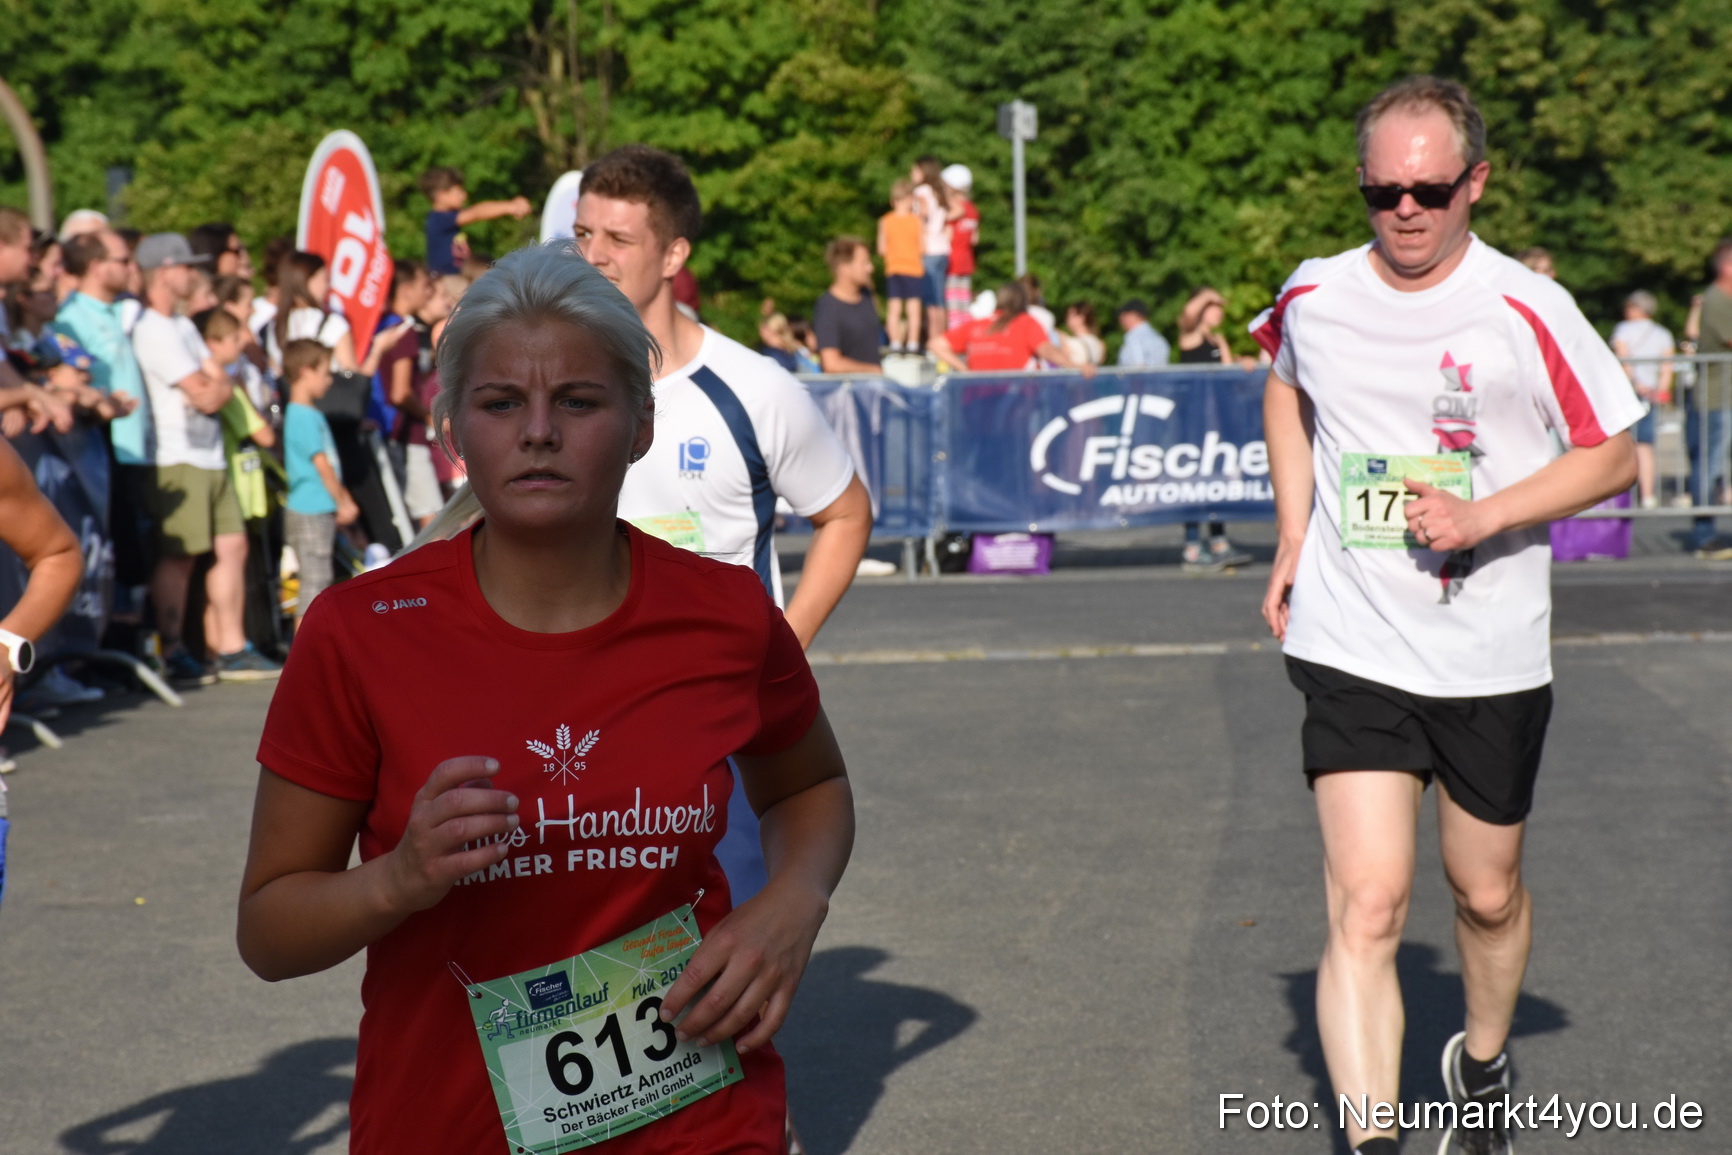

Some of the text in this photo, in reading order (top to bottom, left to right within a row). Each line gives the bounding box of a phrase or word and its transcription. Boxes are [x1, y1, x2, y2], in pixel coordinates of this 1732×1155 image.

[1080, 430, 1270, 481] Fische
[392, 597, 427, 611] JAKO
[543, 761, 587, 773] 18 95
[535, 784, 716, 845] Handwerk
[567, 845, 680, 872] FRISCH
[515, 982, 610, 1029] firmenlauf
[519, 1019, 562, 1035] neumarkt
[545, 996, 678, 1096] 613
[543, 1050, 702, 1124] Schwiertz Amanda
[561, 1073, 694, 1134] Der Bäcker Feihl GmbH
